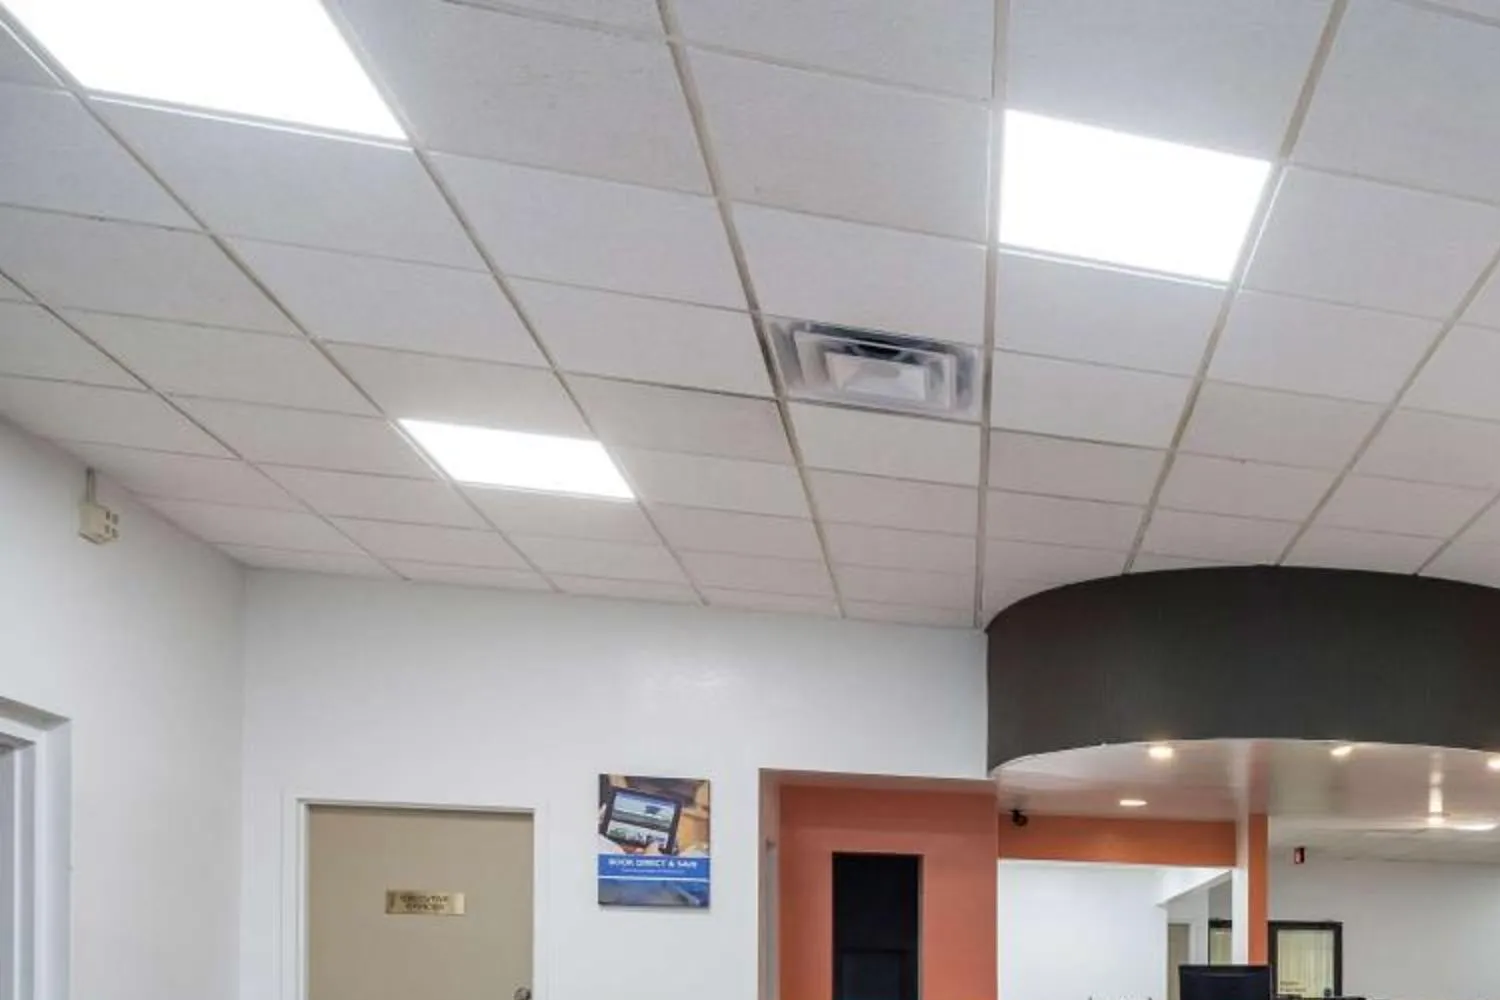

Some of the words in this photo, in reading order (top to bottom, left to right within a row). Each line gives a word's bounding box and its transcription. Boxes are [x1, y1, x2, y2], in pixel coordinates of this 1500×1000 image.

[608, 858, 634, 868] BOOK
[636, 858, 665, 868] DIRECT
[677, 859, 697, 869] SAVE
